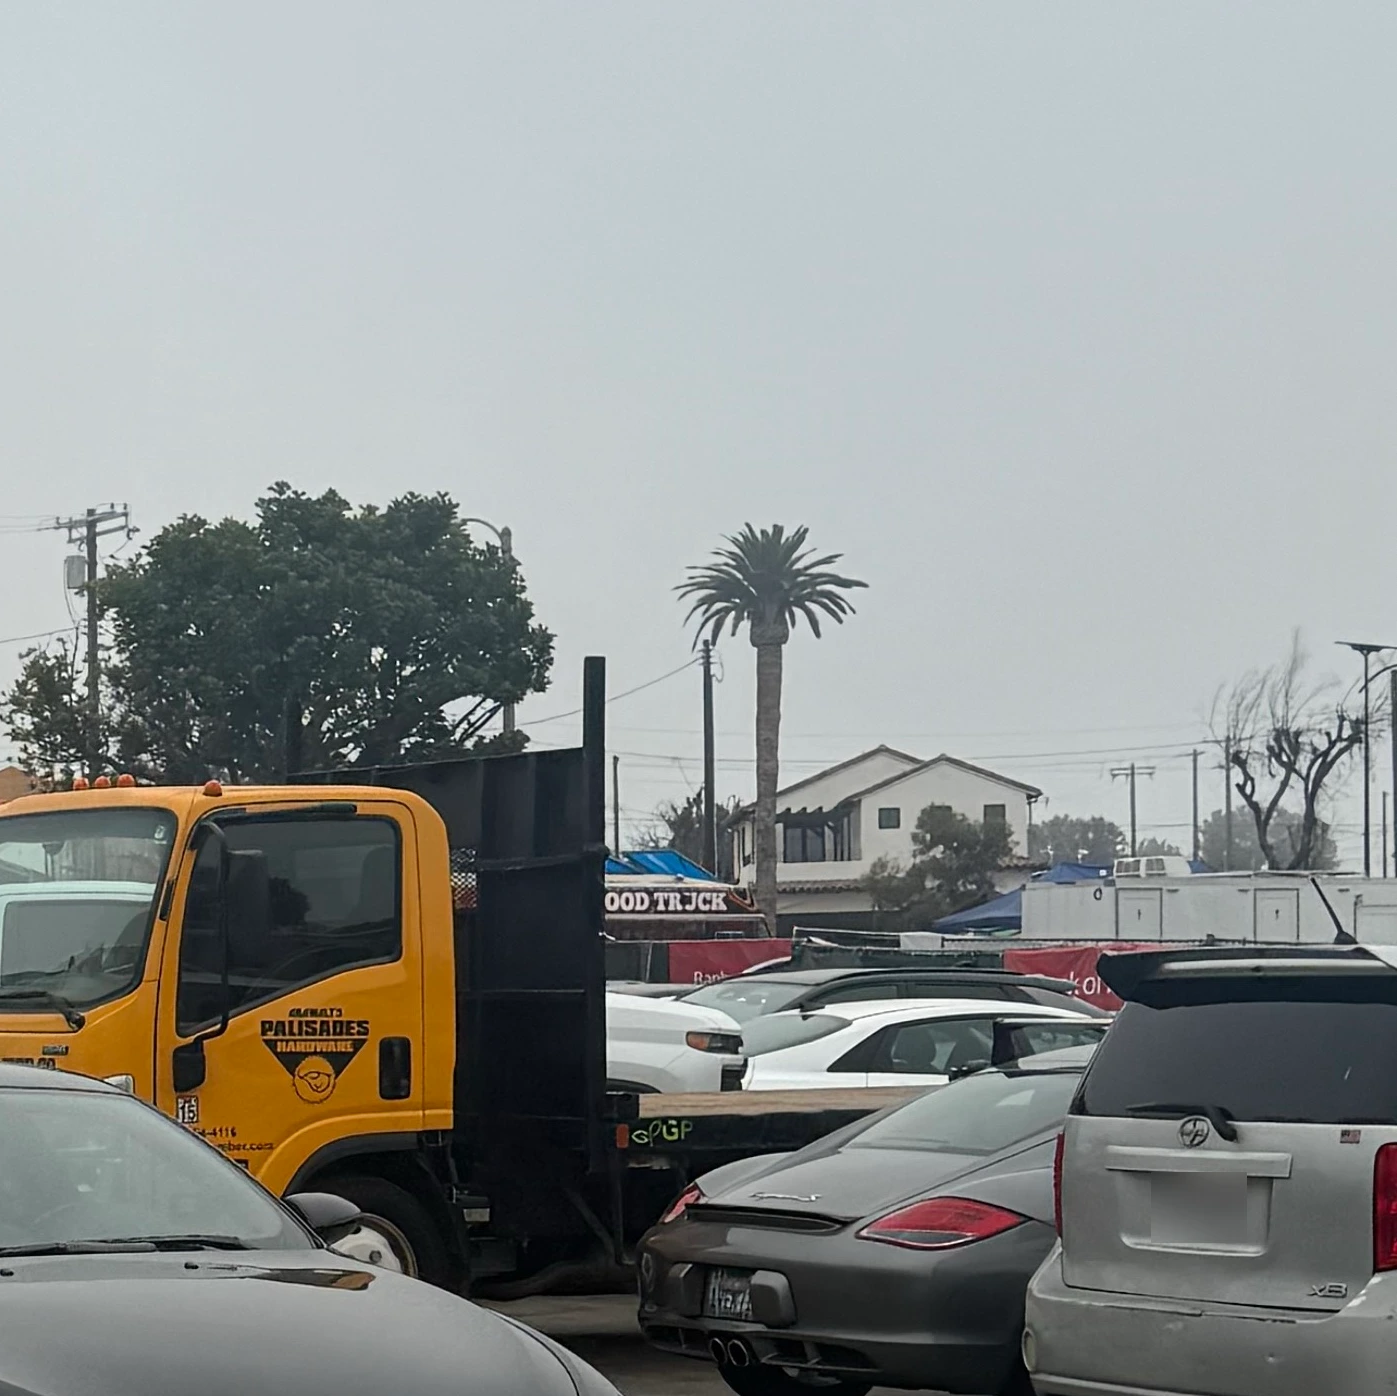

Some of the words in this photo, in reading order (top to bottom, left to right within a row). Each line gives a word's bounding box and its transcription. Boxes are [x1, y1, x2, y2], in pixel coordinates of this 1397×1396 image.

[604, 892, 649, 911] OOD
[260, 1020, 370, 1037] PALISADES
[276, 1040, 354, 1052] HARDWARE
